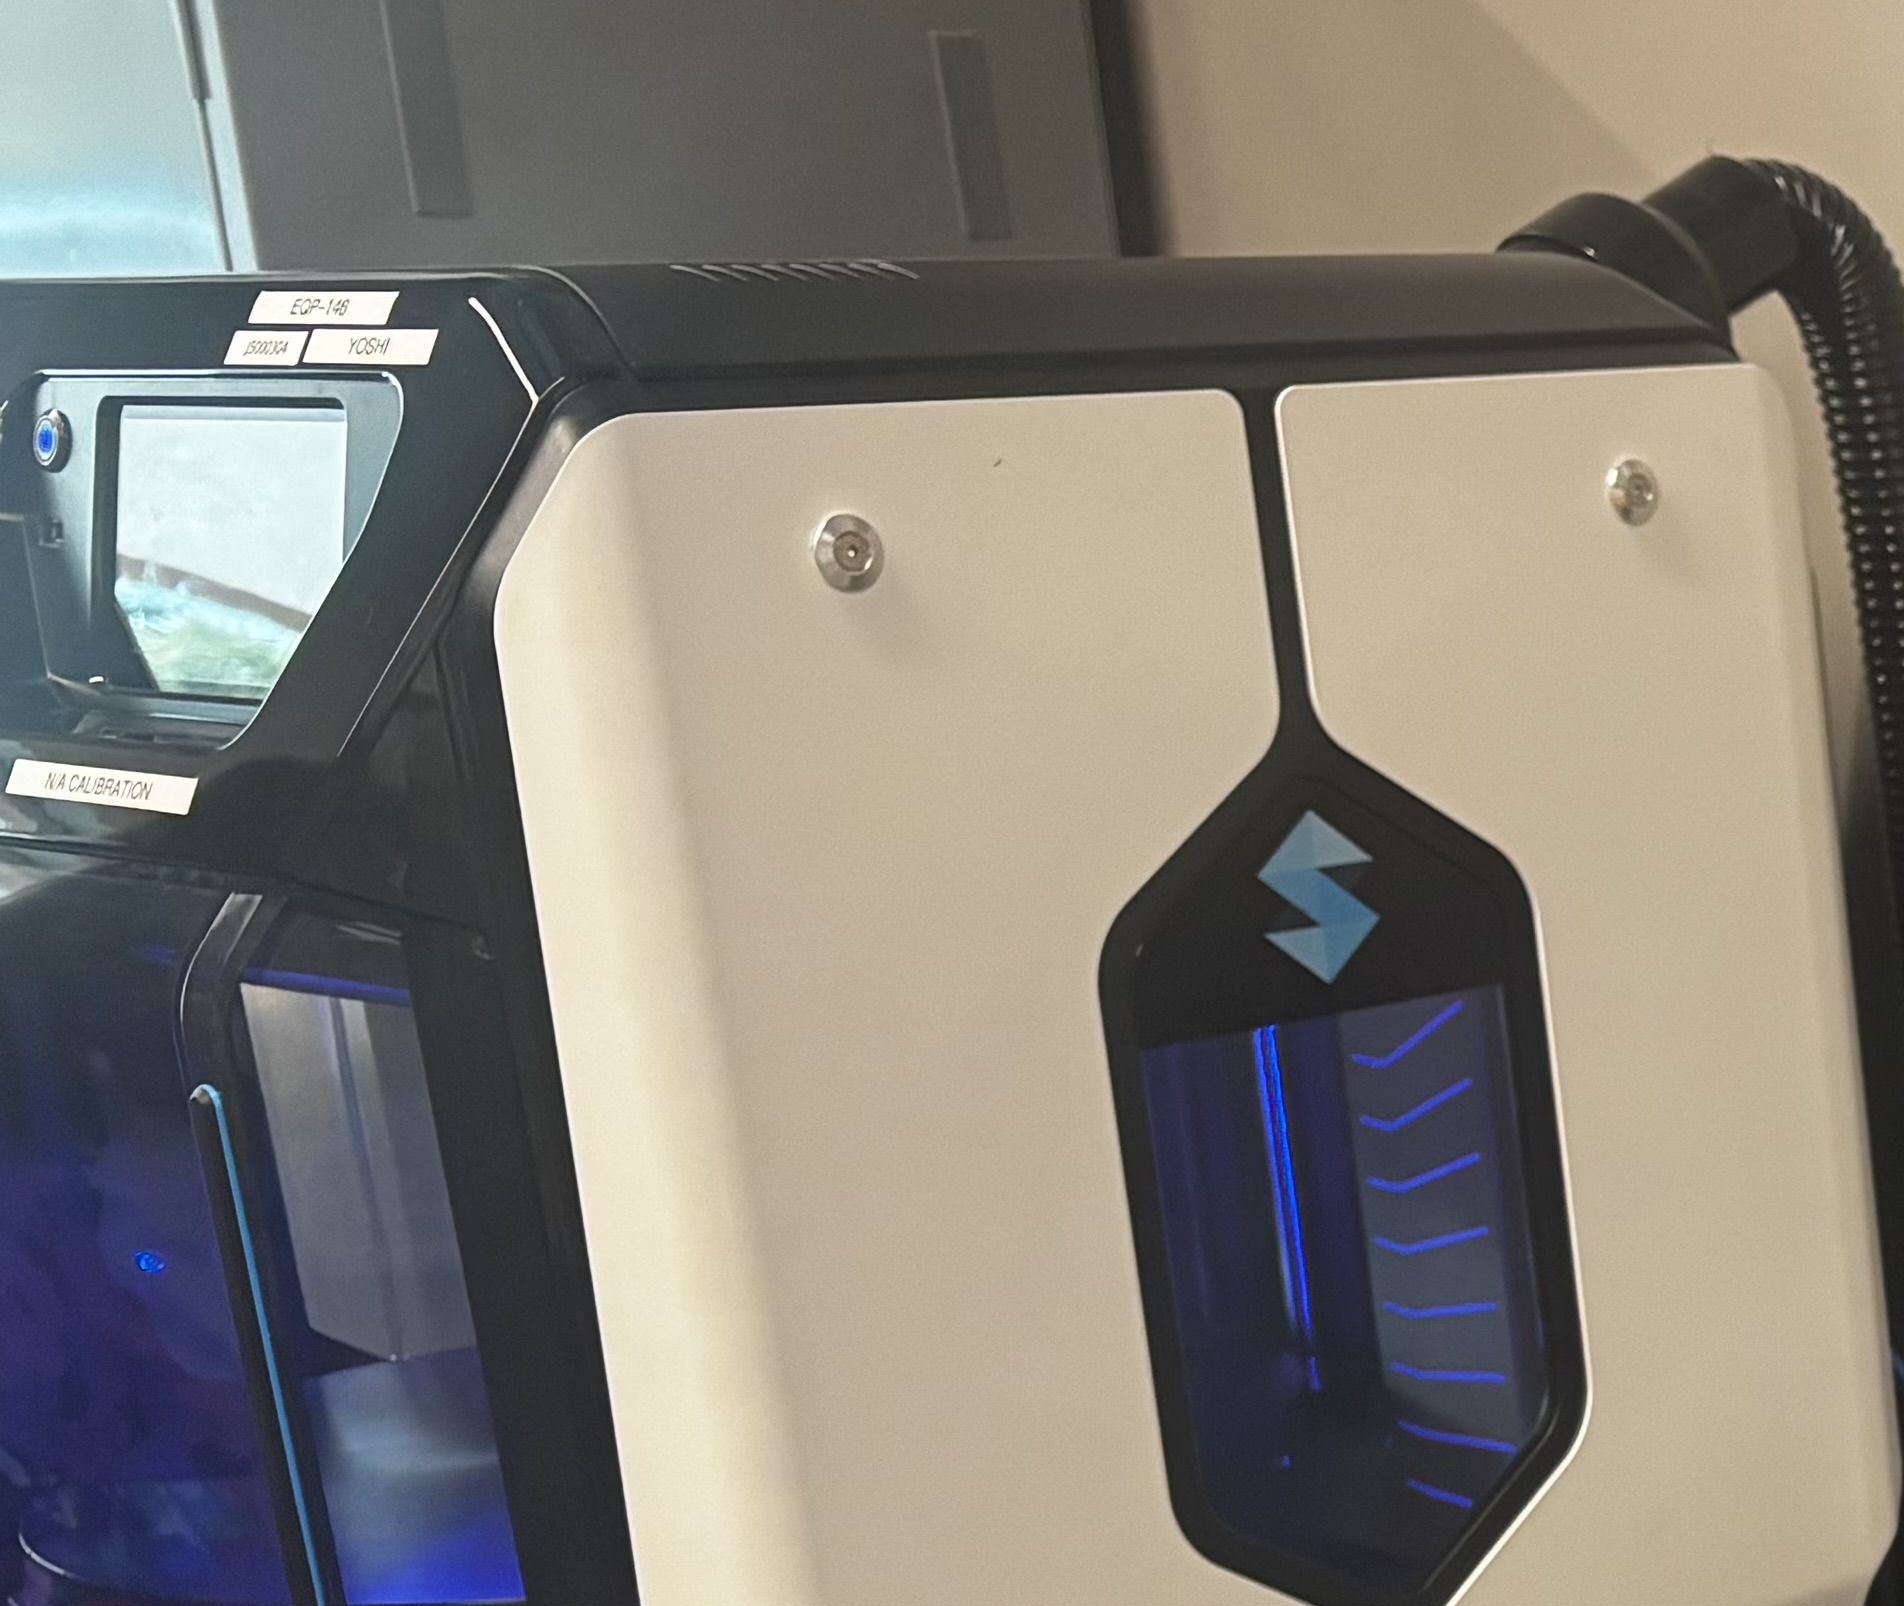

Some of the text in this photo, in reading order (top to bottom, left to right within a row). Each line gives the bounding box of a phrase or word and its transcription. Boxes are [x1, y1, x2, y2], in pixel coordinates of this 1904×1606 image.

[348, 337, 391, 356] YOSHI
[44, 771, 153, 801] N/A CALIBRATION
